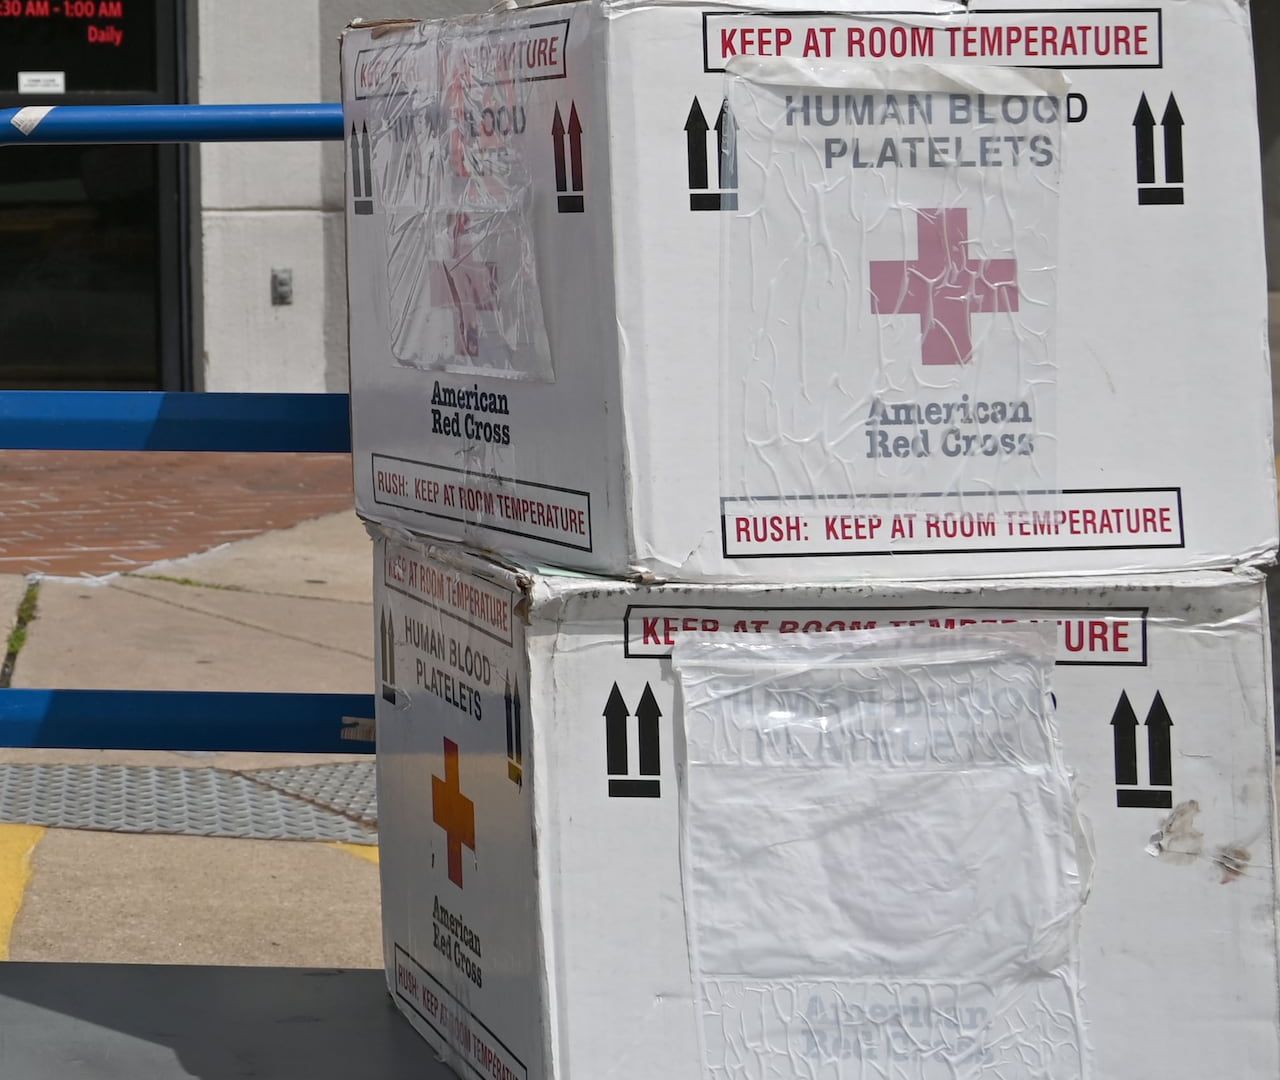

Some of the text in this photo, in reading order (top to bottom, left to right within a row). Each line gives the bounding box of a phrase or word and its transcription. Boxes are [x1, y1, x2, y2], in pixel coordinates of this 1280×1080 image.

[25, 1, 49, 16] AM
[64, 1, 95, 16] 1:00
[99, 2, 123, 17] AM
[88, 26, 123, 46] Daily
[721, 25, 1148, 59] KEEP AT ROOM TEMPERATURE
[786, 93, 1088, 127] HUMAN BLOOD
[825, 135, 1053, 169] PLATELETS
[430, 380, 510, 415] American
[866, 393, 1033, 425] American
[431, 409, 511, 445] Red Cross
[866, 427, 1035, 459] Red Cross
[377, 470, 585, 536] RUSH: KEEP AT ROOM TEMPERATURE
[735, 507, 1173, 543] RUSH: KEEP AT ROOM TEMPERATURE
[408, 562, 418, 588] AT
[420, 565, 444, 600] ROOM
[447, 576, 508, 632] TEMPERATURE
[405, 615, 490, 687] HUMAN BLOOD
[416, 658, 482, 722] PLATELETS
[432, 895, 482, 958] American
[432, 921, 482, 989] Red Cross
[422, 984, 439, 1017] KEEP
